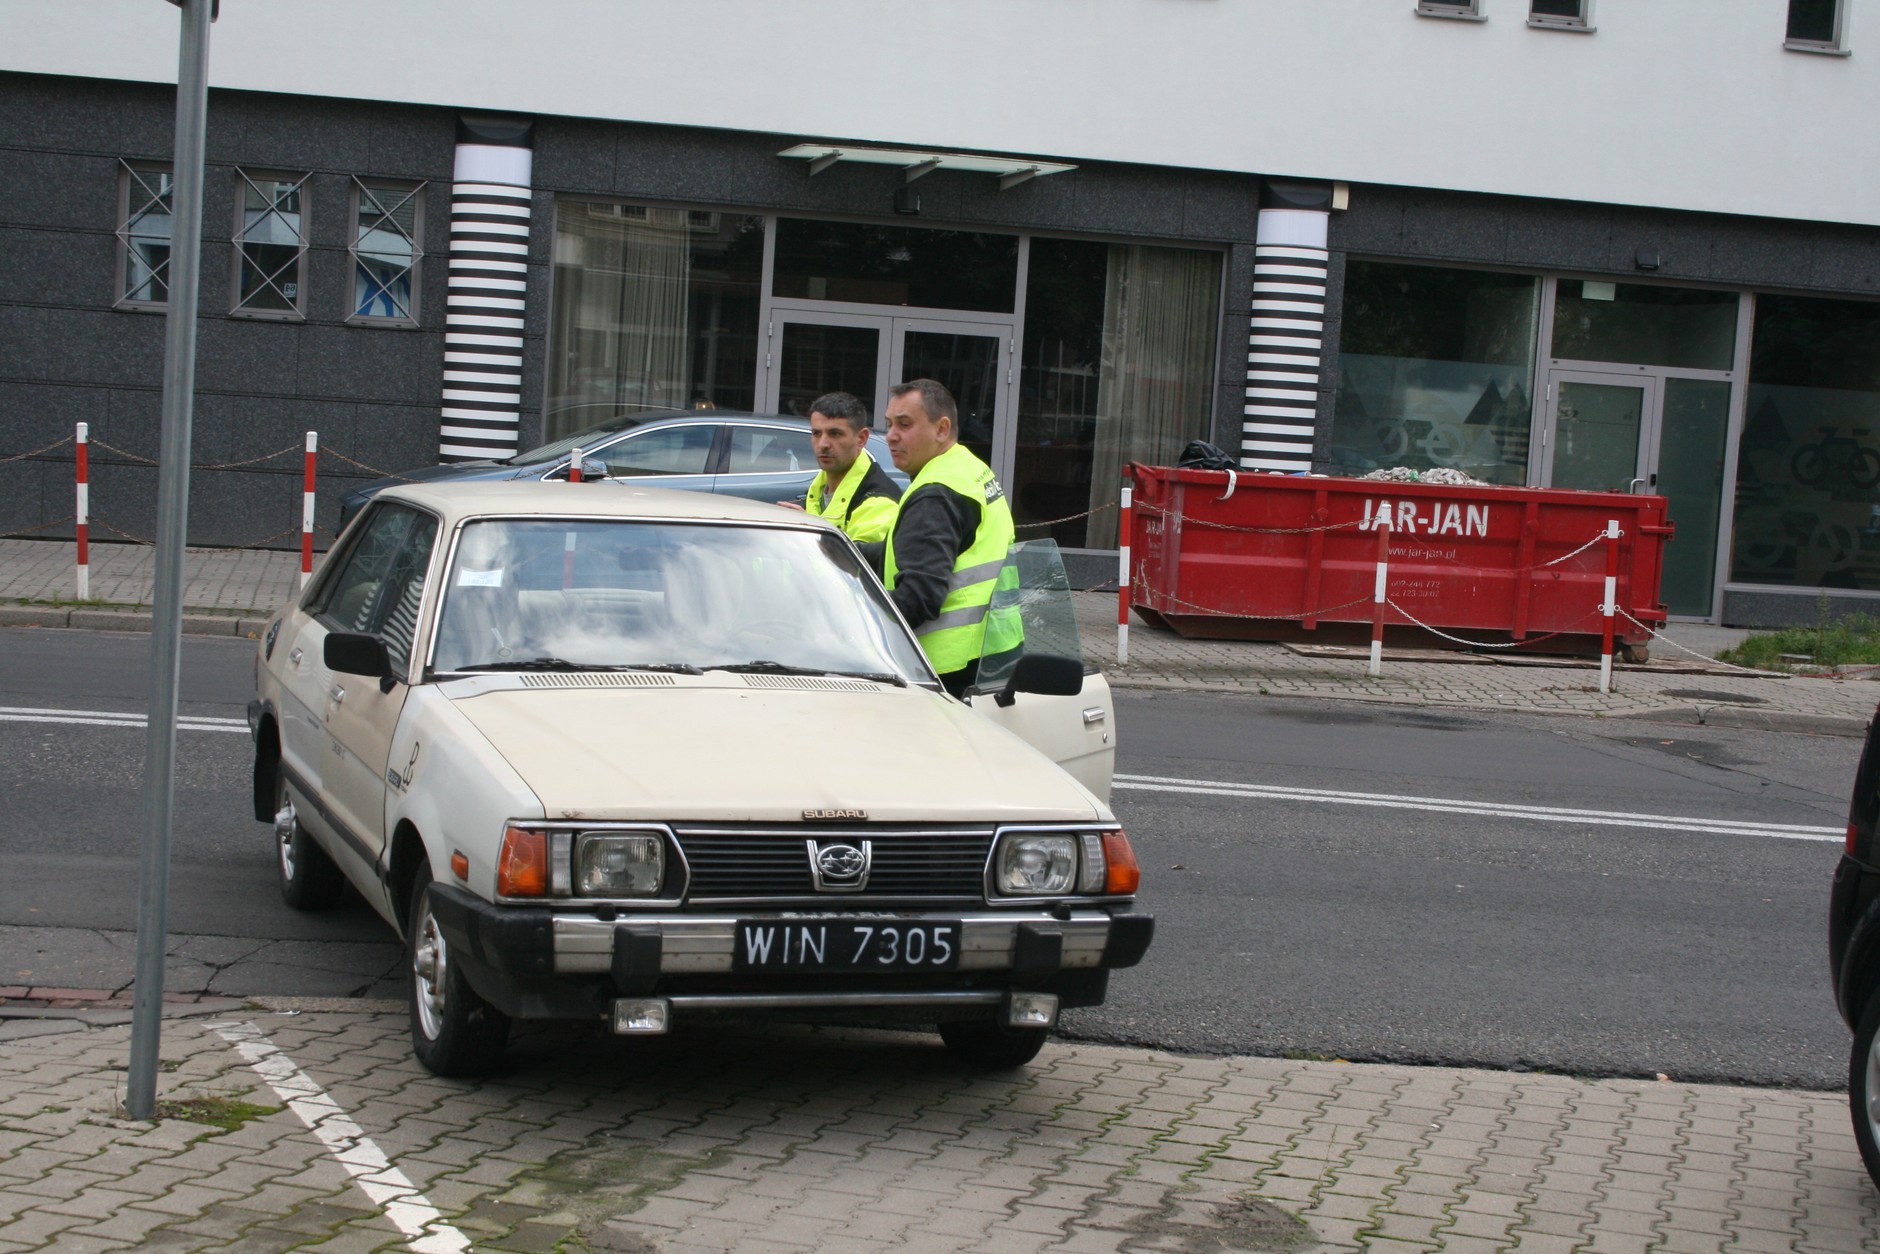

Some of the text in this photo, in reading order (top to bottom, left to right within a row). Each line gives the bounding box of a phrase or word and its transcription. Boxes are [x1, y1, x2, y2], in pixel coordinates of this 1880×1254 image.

[1358, 498, 1489, 536] JAR-JAN
[1388, 545, 1456, 560] ww.jar-jan.pl
[804, 809, 867, 818] SUBARU
[744, 926, 953, 965] WIN 7305
